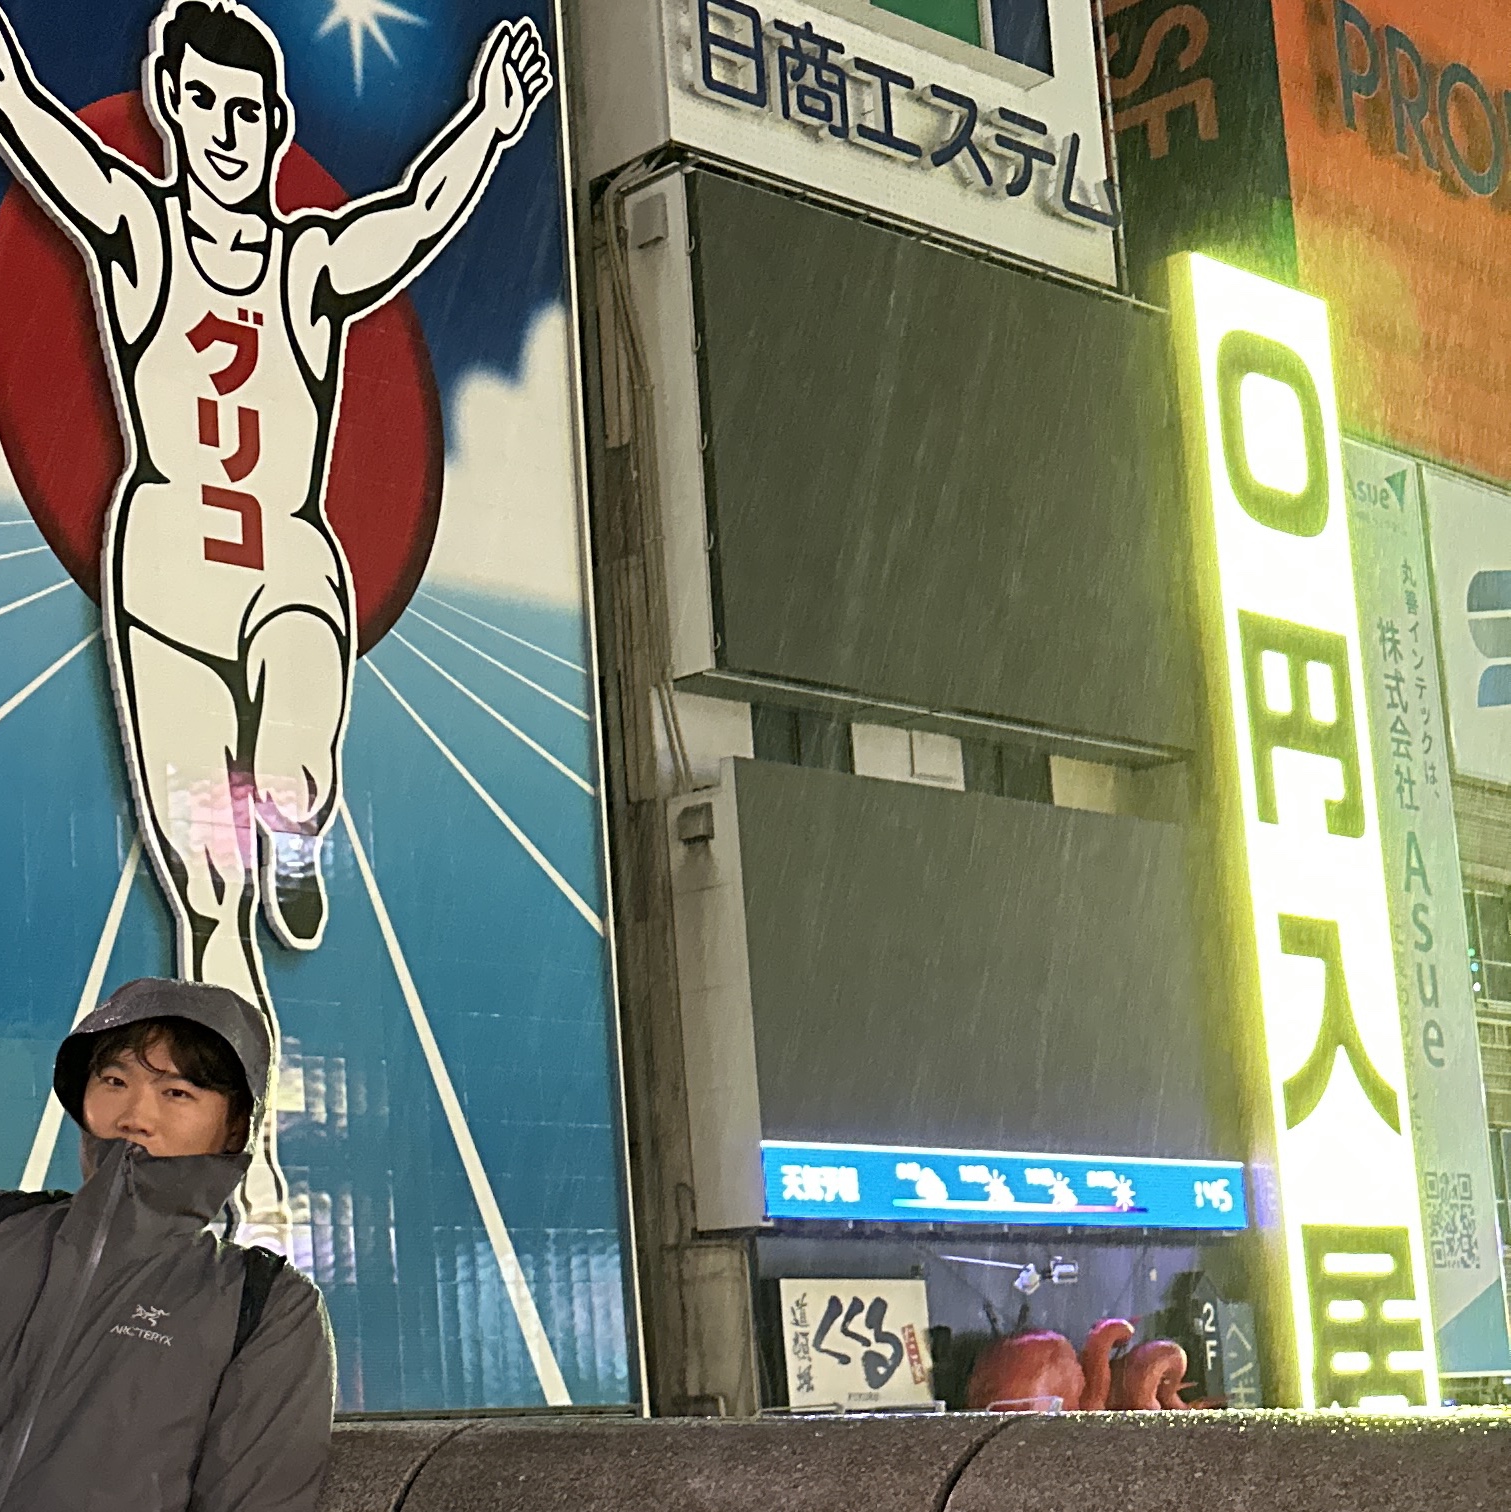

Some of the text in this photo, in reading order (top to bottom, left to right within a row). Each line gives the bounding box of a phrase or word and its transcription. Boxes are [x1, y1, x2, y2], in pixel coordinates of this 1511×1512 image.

[699, 0, 1121, 228] 日商エステム
[1333, 0, 1511, 196] PRO
[185, 307, 265, 571] グリコ
[1376, 617, 1419, 811] 株式会社
[1403, 831, 1445, 1067] Asue
